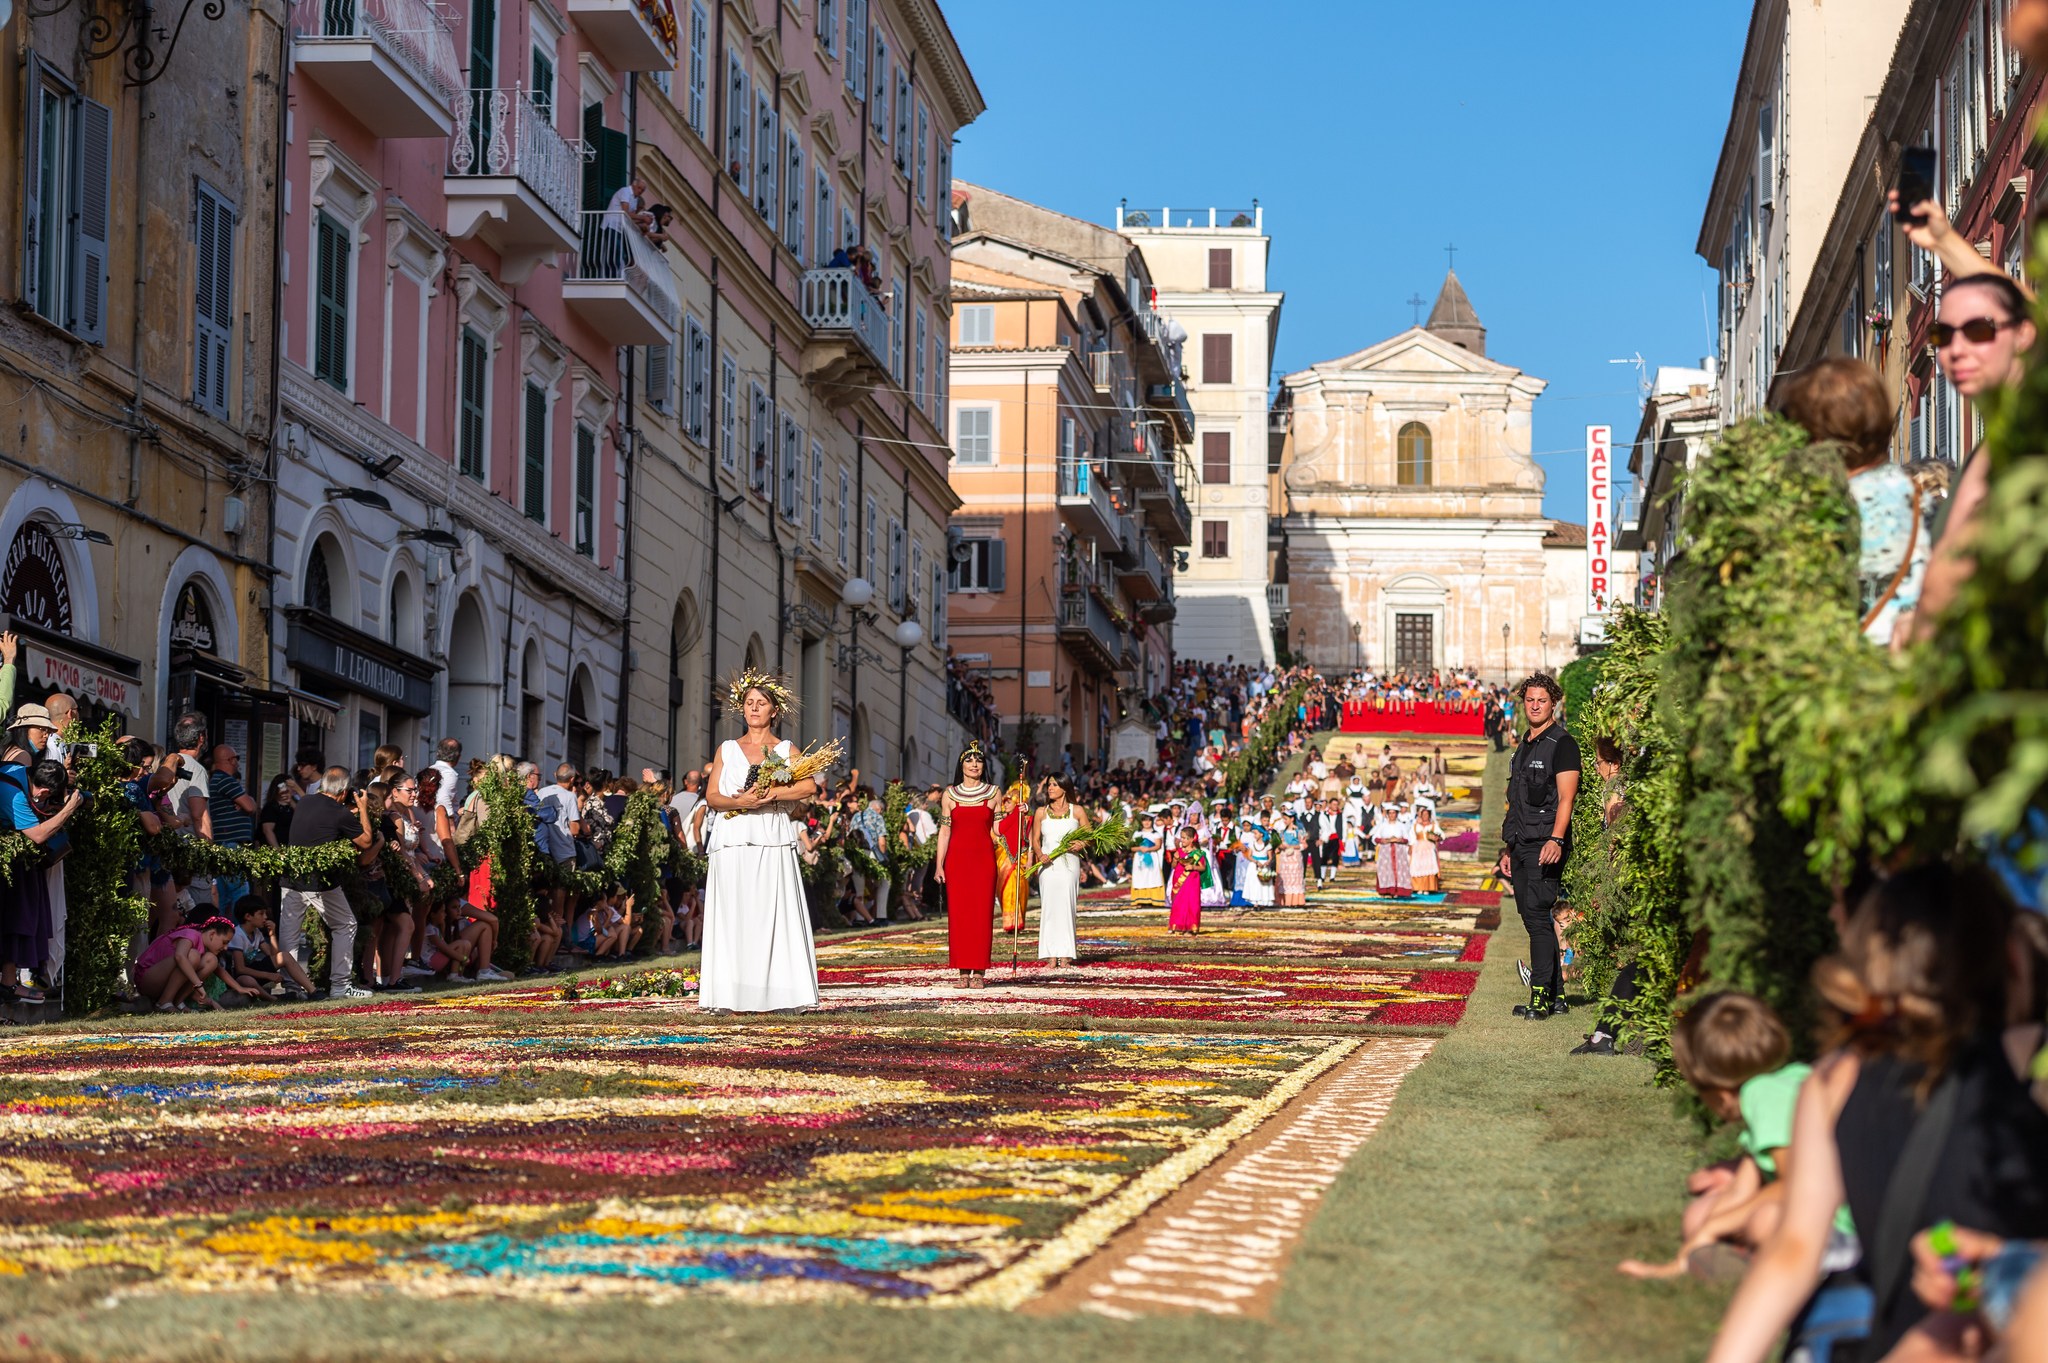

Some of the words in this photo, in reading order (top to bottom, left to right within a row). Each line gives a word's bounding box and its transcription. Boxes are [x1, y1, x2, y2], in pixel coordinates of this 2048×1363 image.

[1591, 428, 1607, 612] CACCIATORI
[335, 646, 345, 676] IL
[349, 652, 404, 700] LEONARDO
[460, 715, 470, 726] 71
